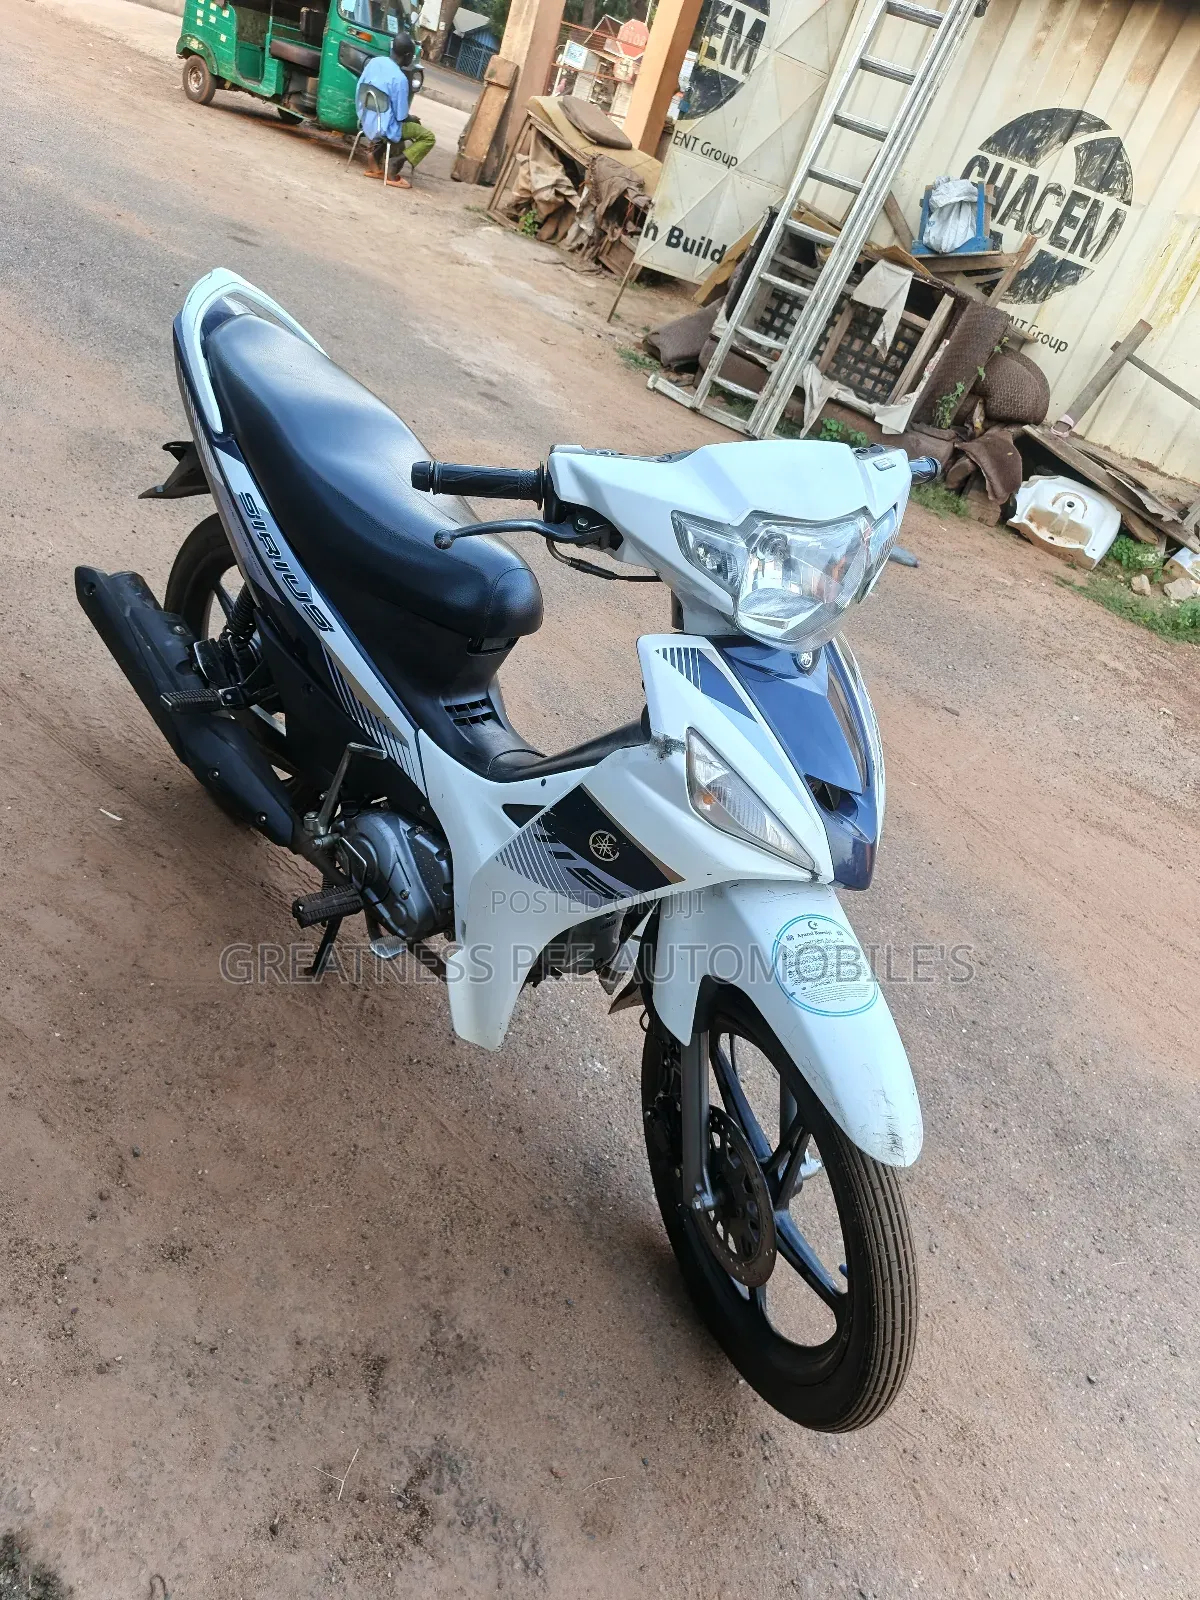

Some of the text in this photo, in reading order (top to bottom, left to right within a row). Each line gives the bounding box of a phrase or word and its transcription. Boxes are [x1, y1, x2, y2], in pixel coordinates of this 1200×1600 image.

[700, 141, 738, 169] Group
[665, 225, 727, 264] Build
[239, 492, 336, 632] SIRIUS
